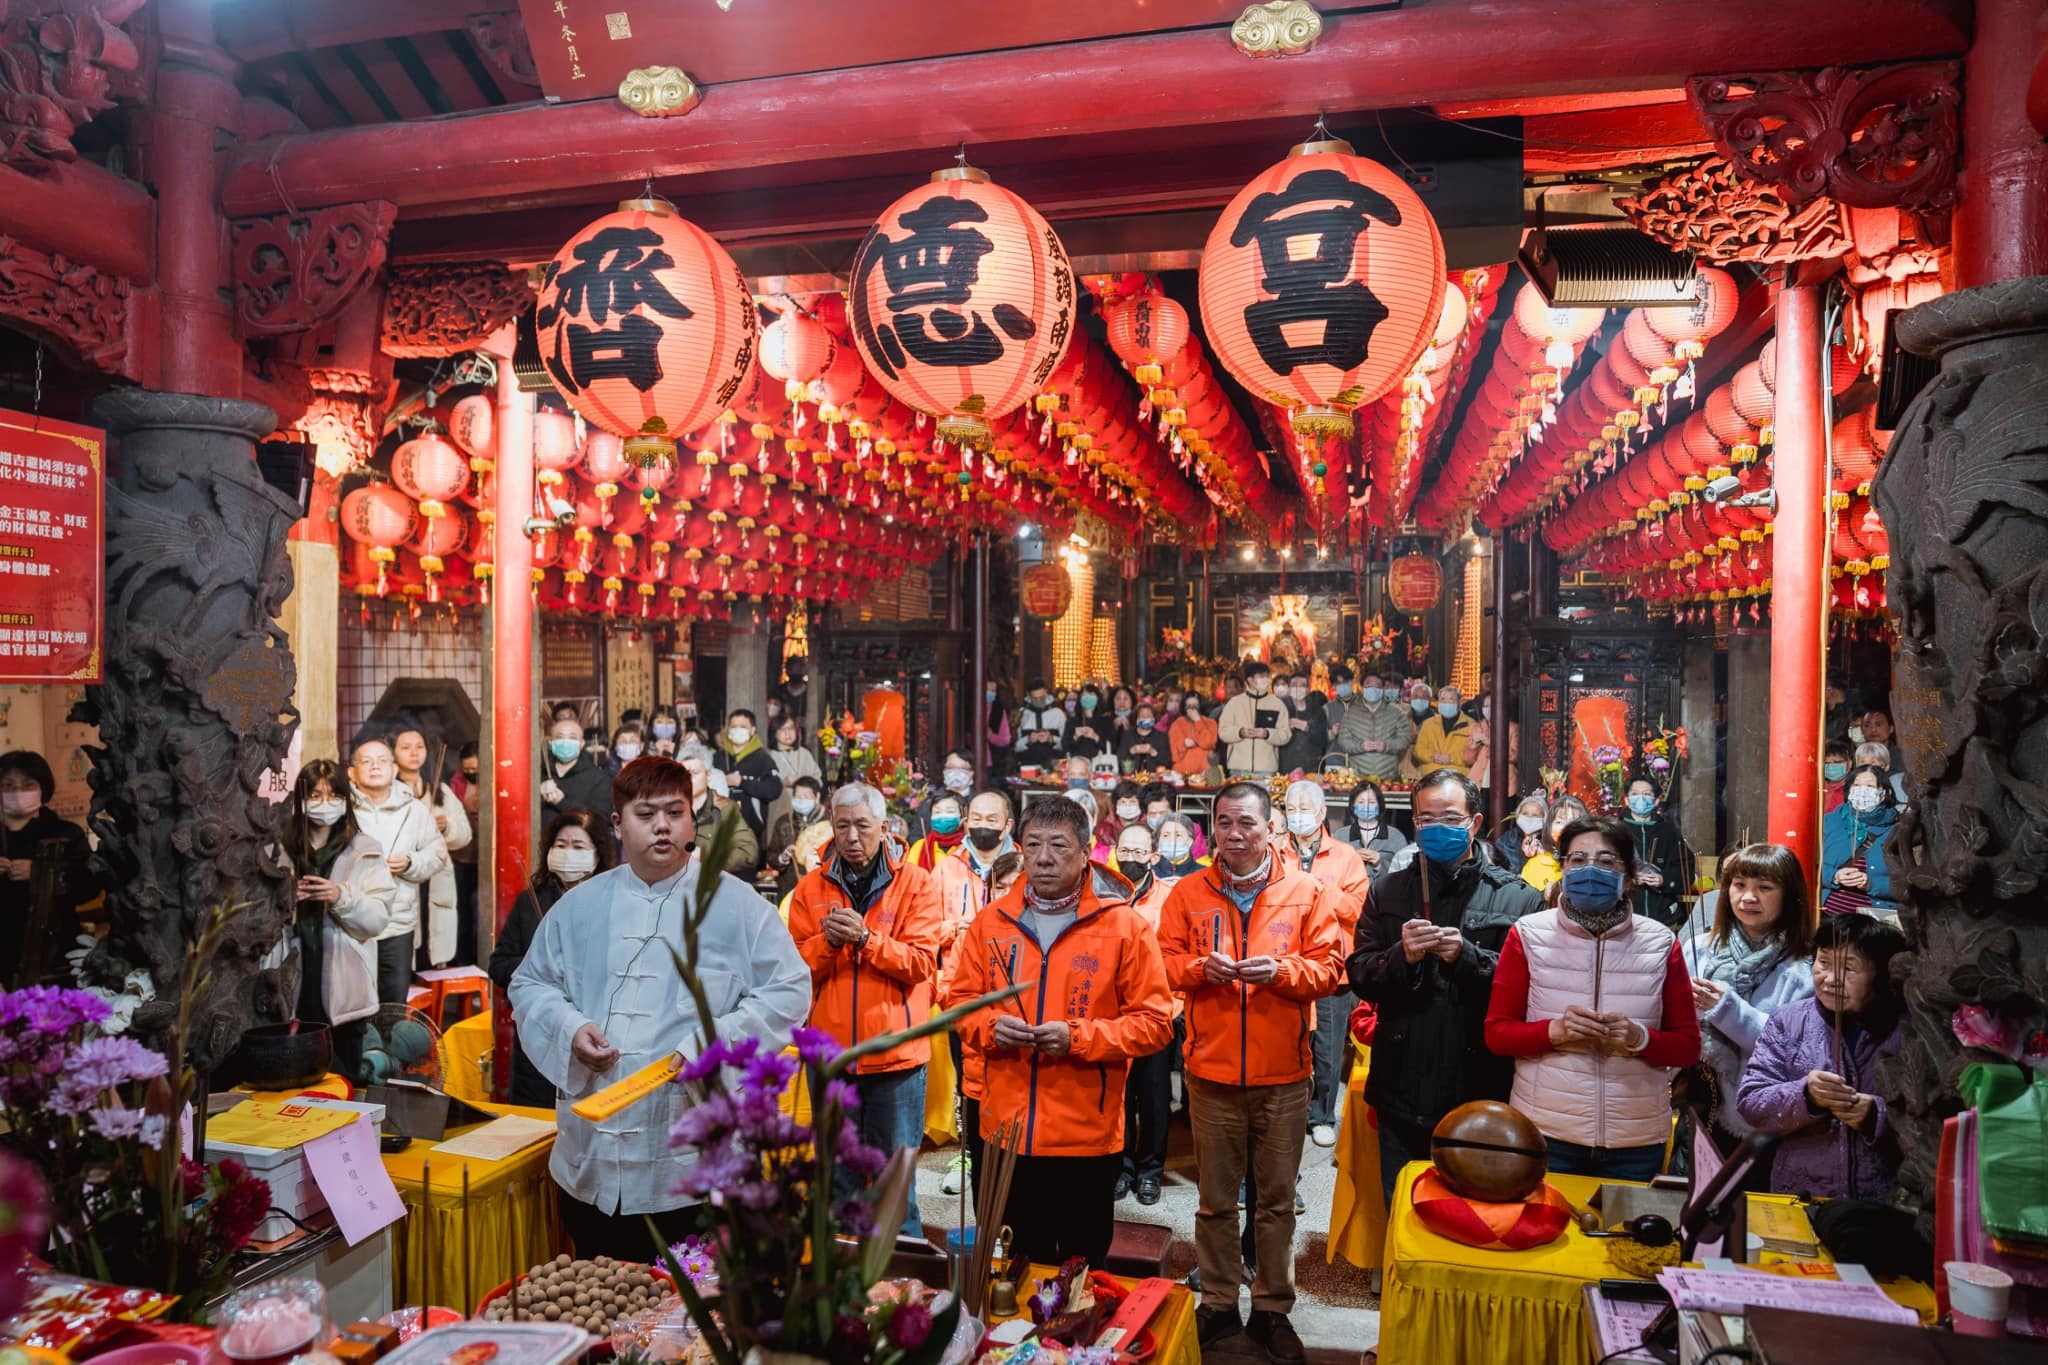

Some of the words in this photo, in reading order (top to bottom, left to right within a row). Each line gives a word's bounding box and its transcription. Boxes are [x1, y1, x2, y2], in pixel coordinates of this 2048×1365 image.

[537, 227, 694, 395] 濟
[850, 196, 1036, 381] 德
[1230, 169, 1401, 376] 宮
